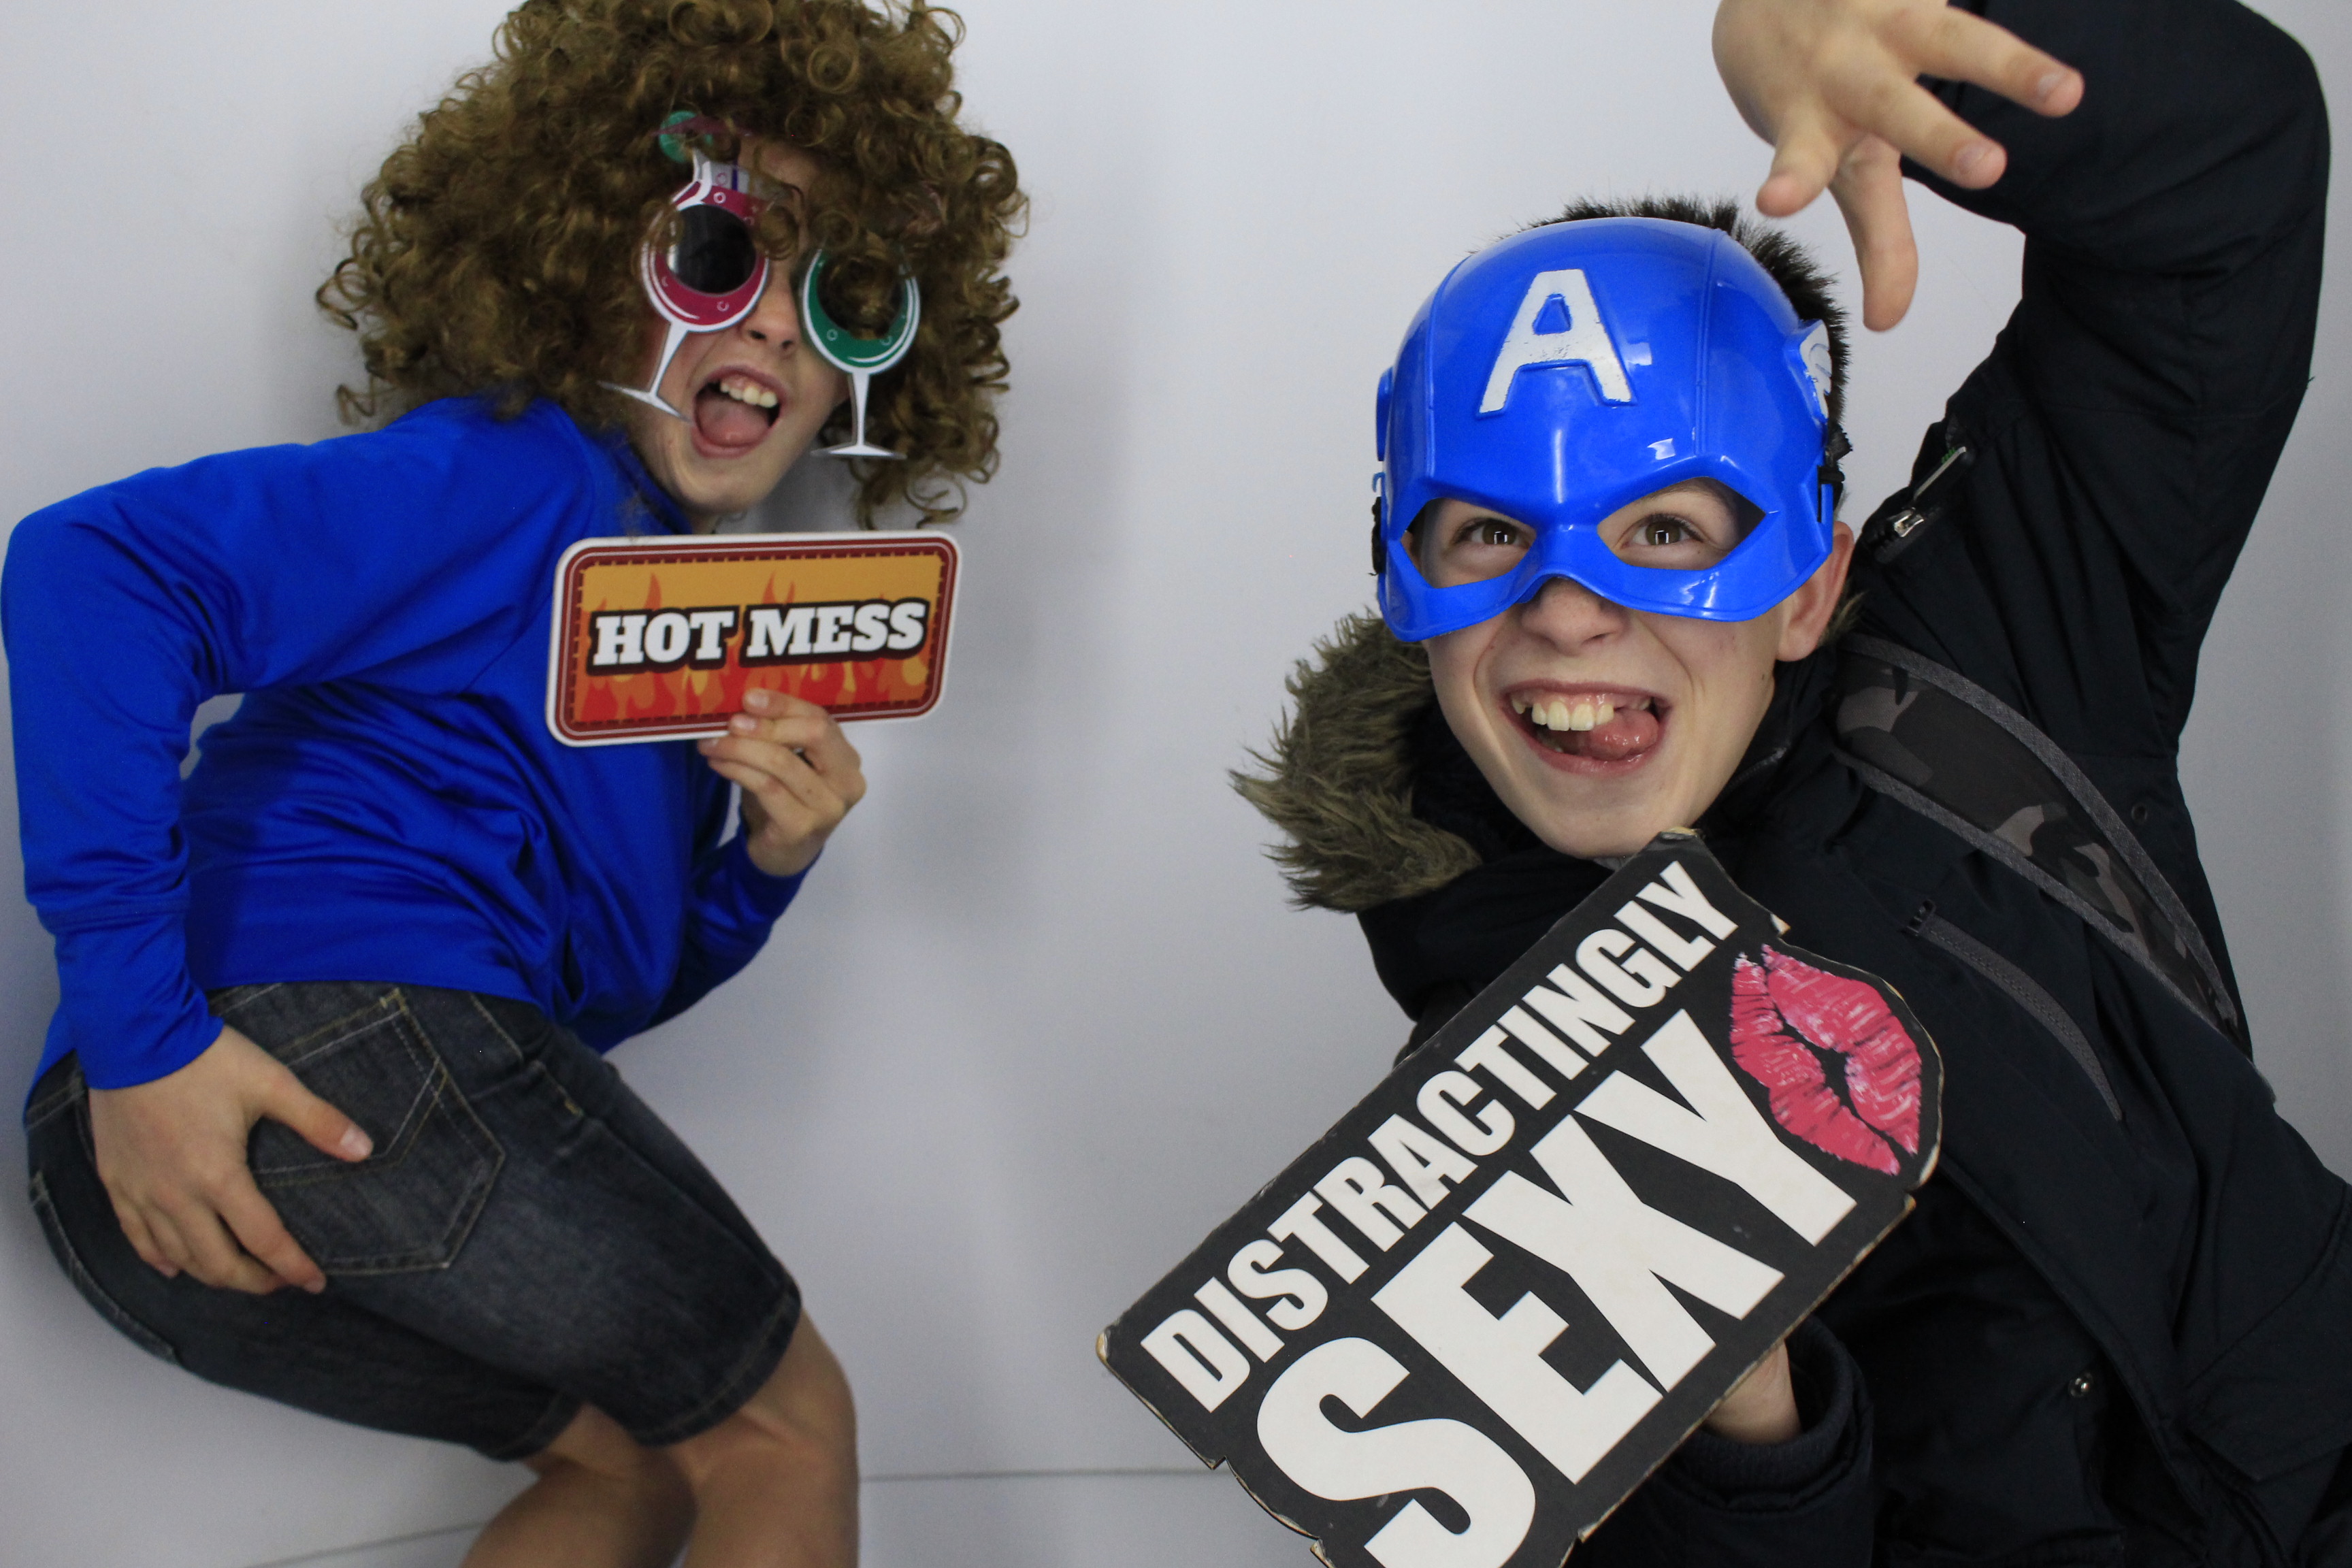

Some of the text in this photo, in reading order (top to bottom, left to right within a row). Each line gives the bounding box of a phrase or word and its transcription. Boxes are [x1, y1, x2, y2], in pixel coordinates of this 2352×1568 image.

[1478, 268, 1632, 414] A
[592, 602, 927, 666] HOT MESS
[1139, 860, 1738, 1414] DISTRACTINGLY
[1256, 1009, 1858, 1568] SEXY
